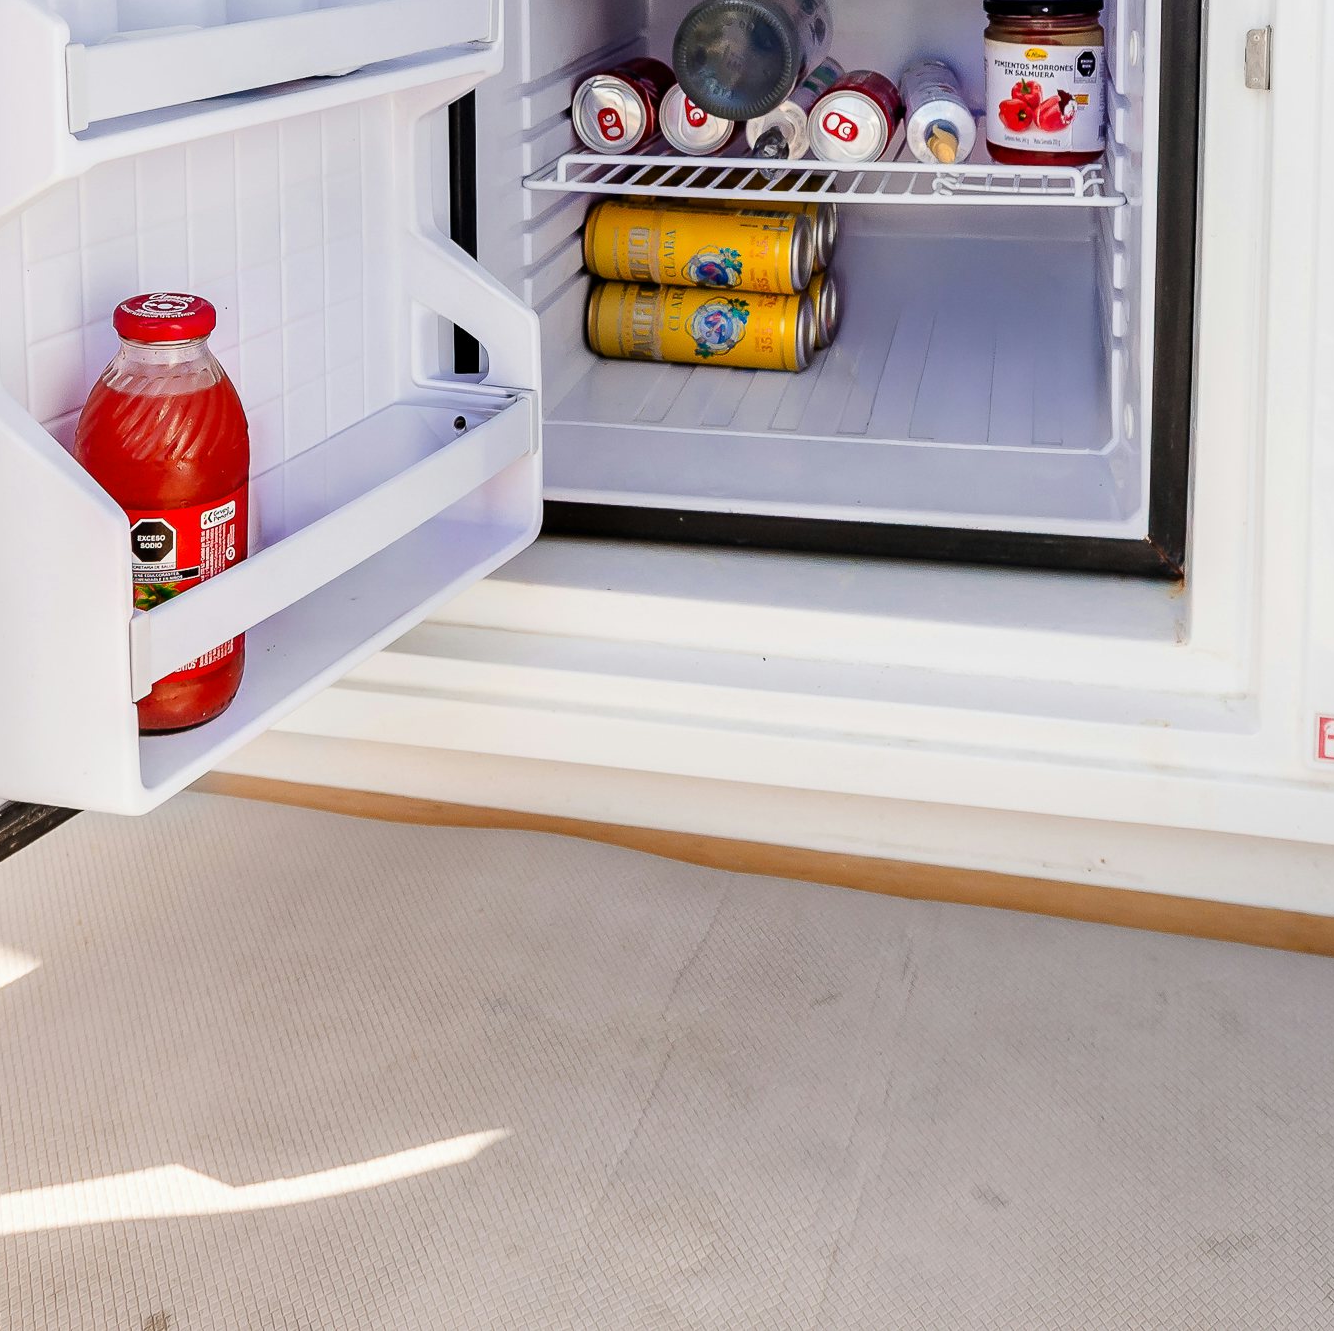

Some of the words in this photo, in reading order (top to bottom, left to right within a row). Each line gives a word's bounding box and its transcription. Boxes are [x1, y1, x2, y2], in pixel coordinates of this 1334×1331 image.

[994, 59, 1030, 70] PIMIENTOS
[1031, 64, 1074, 72] MORRONES
[1004, 68, 1013, 76] EN
[1015, 69, 1055, 79] SALMUERA
[663, 230, 677, 278] CLARA
